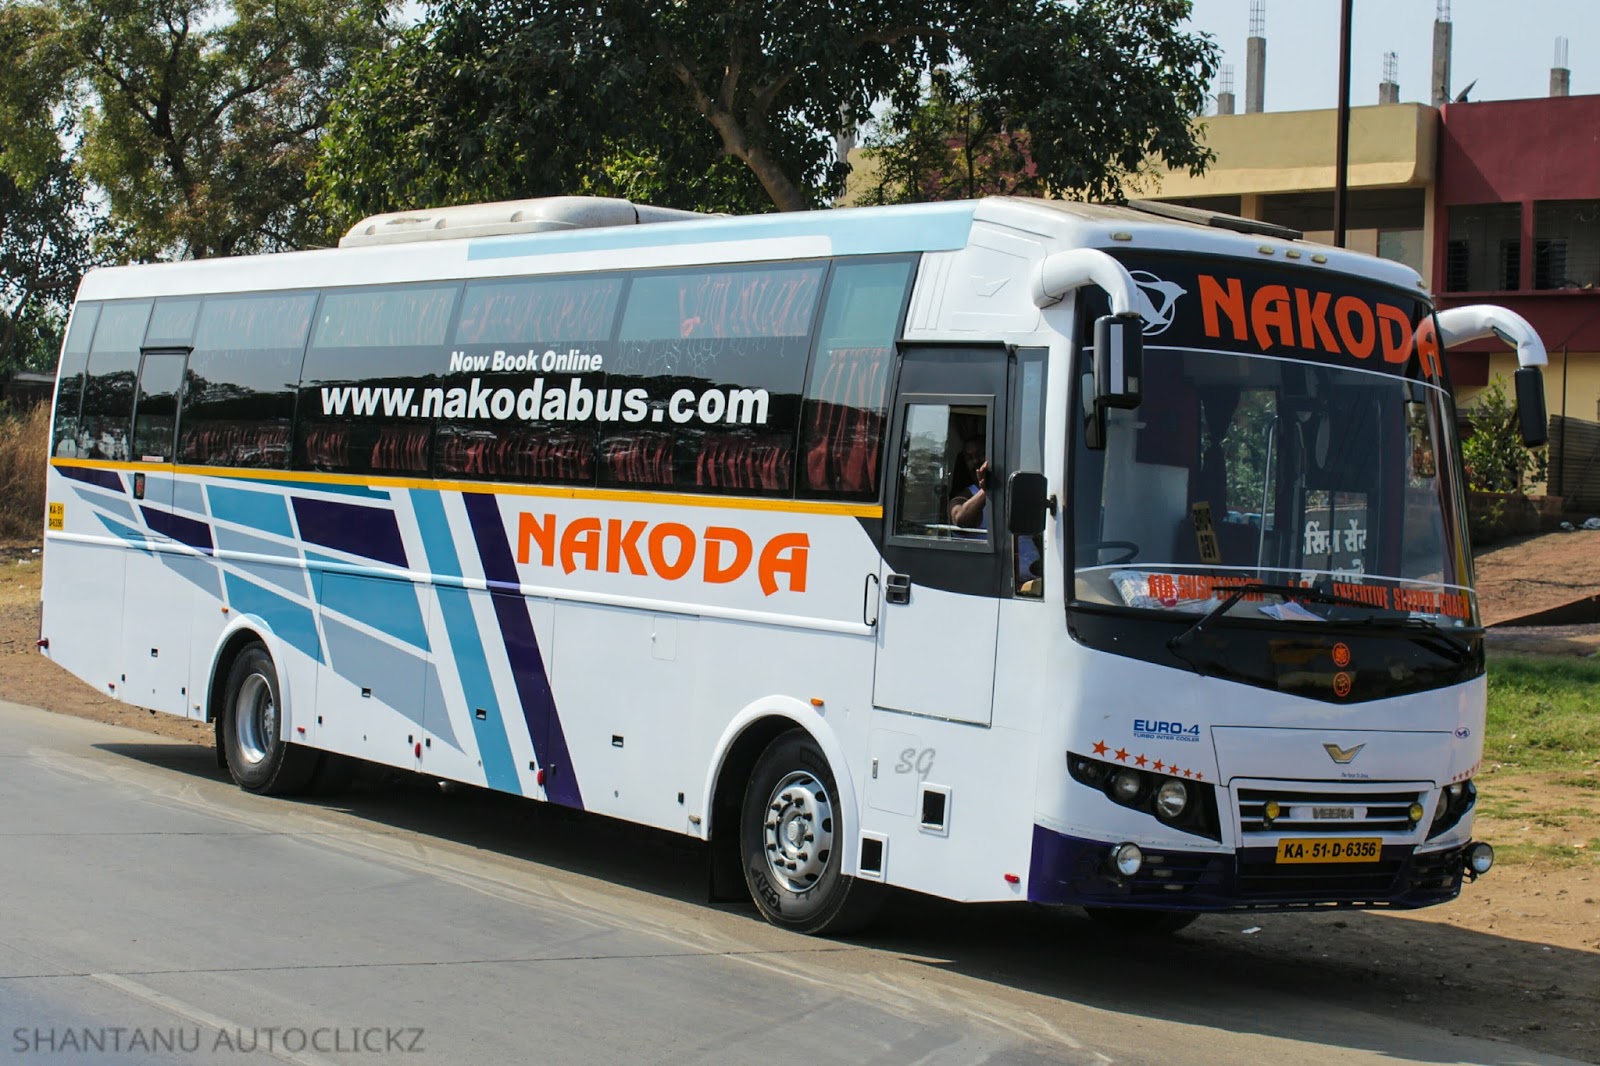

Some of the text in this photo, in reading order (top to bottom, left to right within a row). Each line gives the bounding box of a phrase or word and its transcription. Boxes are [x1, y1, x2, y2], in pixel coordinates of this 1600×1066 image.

[1198, 274, 1443, 379] NAKODA
[449, 349, 603, 372] Now Book Online
[320, 377, 770, 425] www.nakodabus.com
[517, 511, 811, 597] NAKODA
[1148, 574, 1173, 599] AIR
[1333, 583, 1390, 610] EXECUTIVE
[1393, 587, 1436, 615] SLEEPER
[1439, 593, 1470, 619] COACH
[1133, 719, 1200, 735] EURO-4
[1312, 807, 1354, 819] VEERA
[755, 872, 779, 907] CEAT
